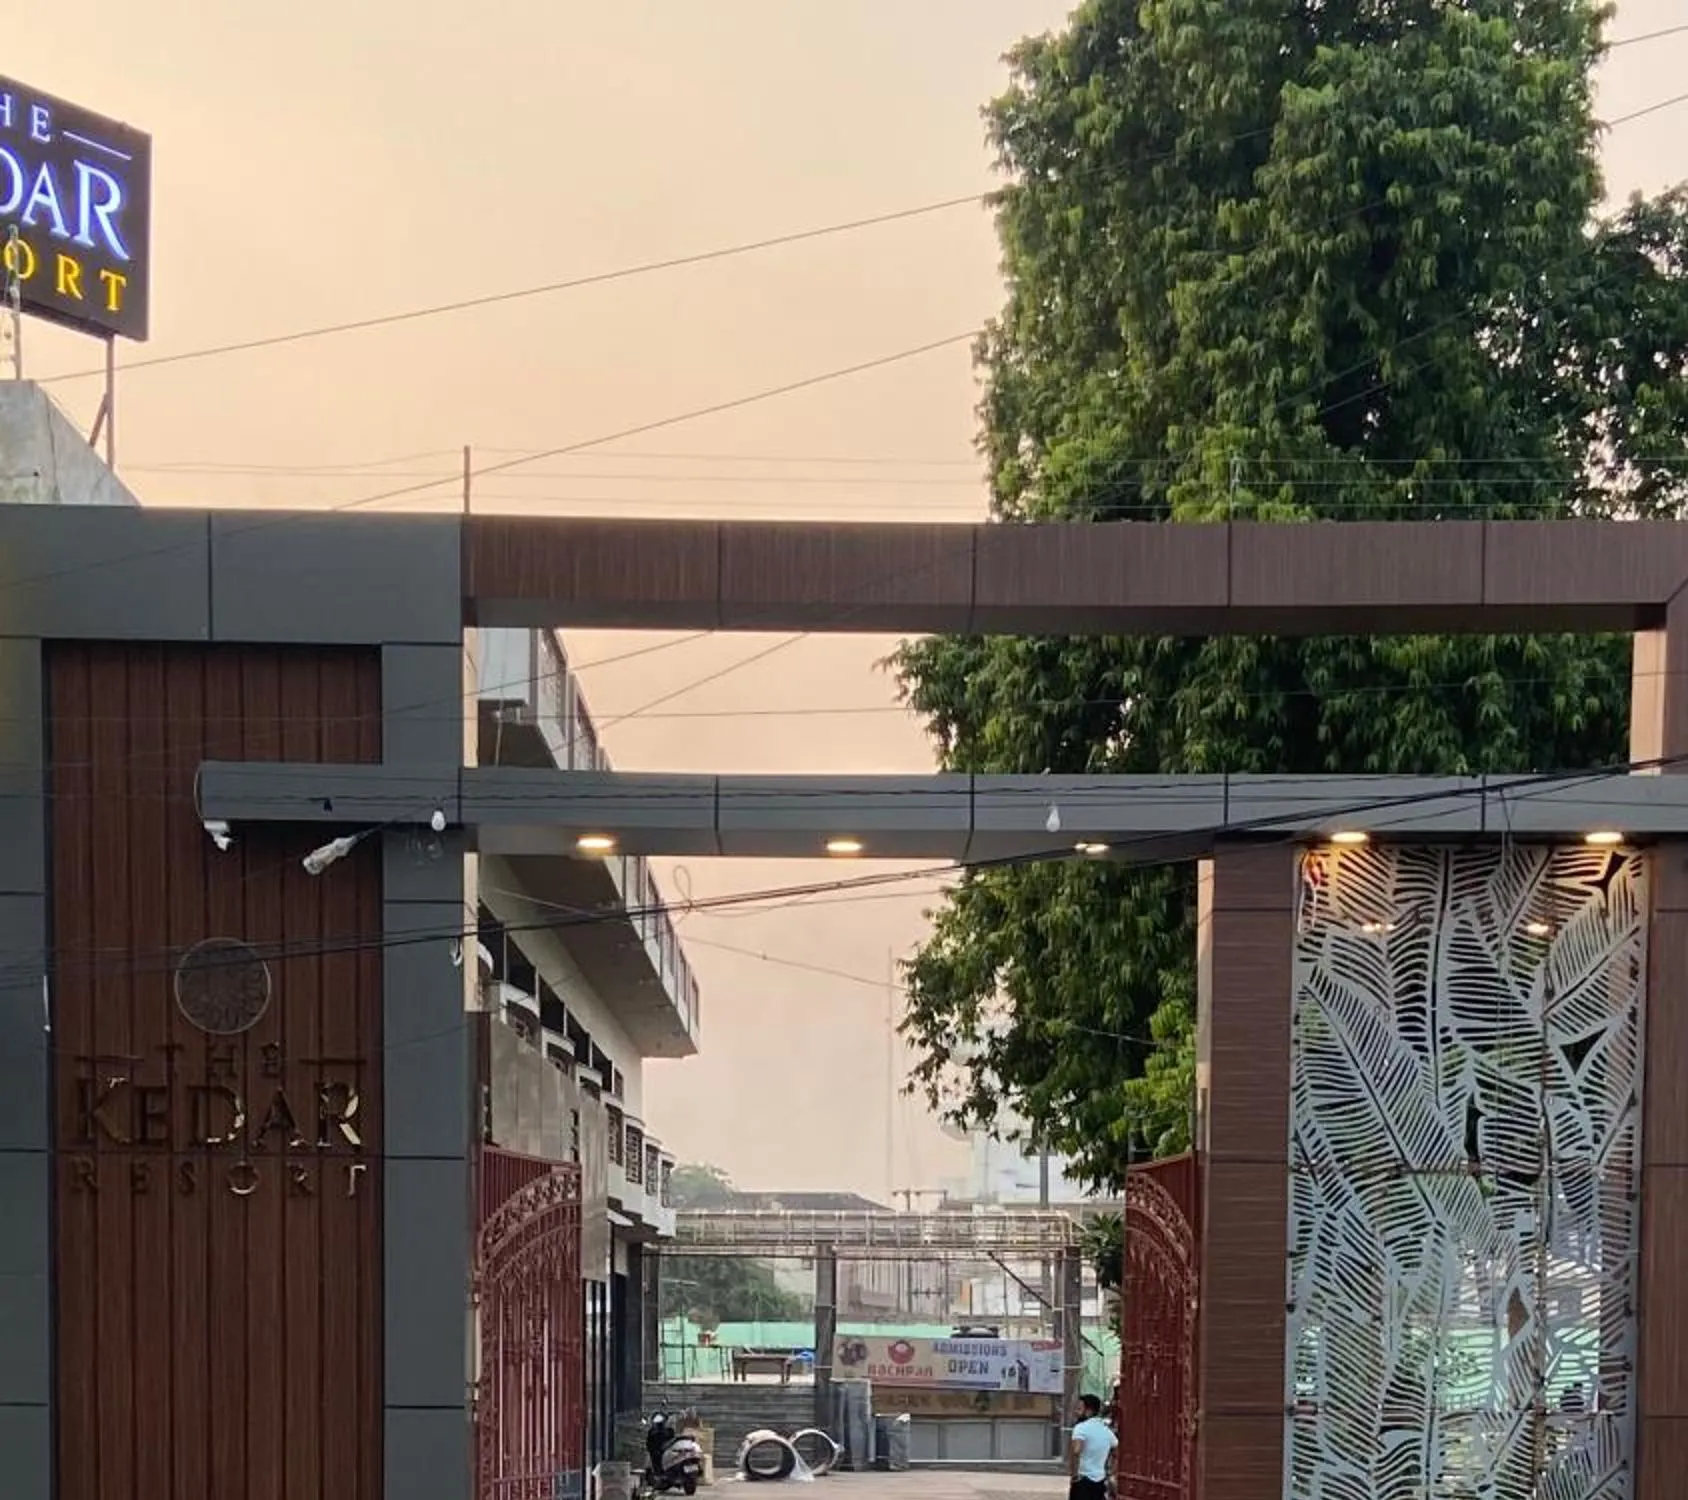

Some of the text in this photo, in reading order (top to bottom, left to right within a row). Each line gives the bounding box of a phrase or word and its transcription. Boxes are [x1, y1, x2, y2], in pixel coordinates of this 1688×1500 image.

[154, 1042, 283, 1079] THE
[74, 1077, 361, 1148] KEDAR
[70, 1156, 367, 1197] RESORT
[933, 1341, 1008, 1357] ADMISSIONS
[947, 1359, 989, 1376] OPEN
